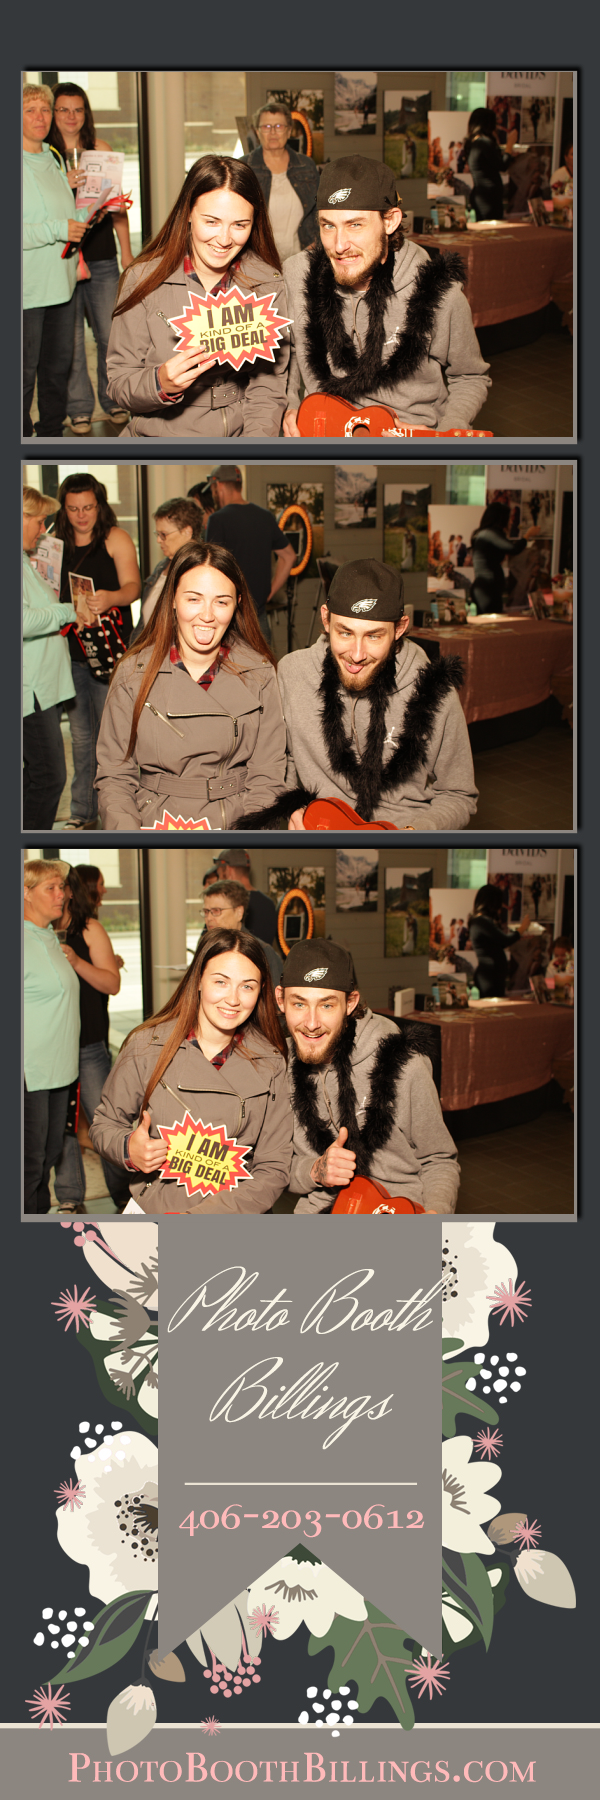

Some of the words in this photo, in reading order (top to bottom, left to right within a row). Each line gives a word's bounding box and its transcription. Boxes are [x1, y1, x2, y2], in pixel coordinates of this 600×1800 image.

[207, 309, 214, 329] I
[221, 303, 255, 327] AM
[200, 327, 232, 339] KIND
[235, 323, 253, 332] OF
[256, 321, 265, 329] A
[200, 336, 226, 353] BIG
[230, 329, 268, 349] DEAL
[175, 1149, 203, 1162] KIND
[205, 1158, 221, 1167] OF
[186, 1133, 196, 1151] I
[197, 1137, 230, 1162] AM
[168, 1155, 193, 1174] BIG
[194, 1164, 227, 1185] DEAL
